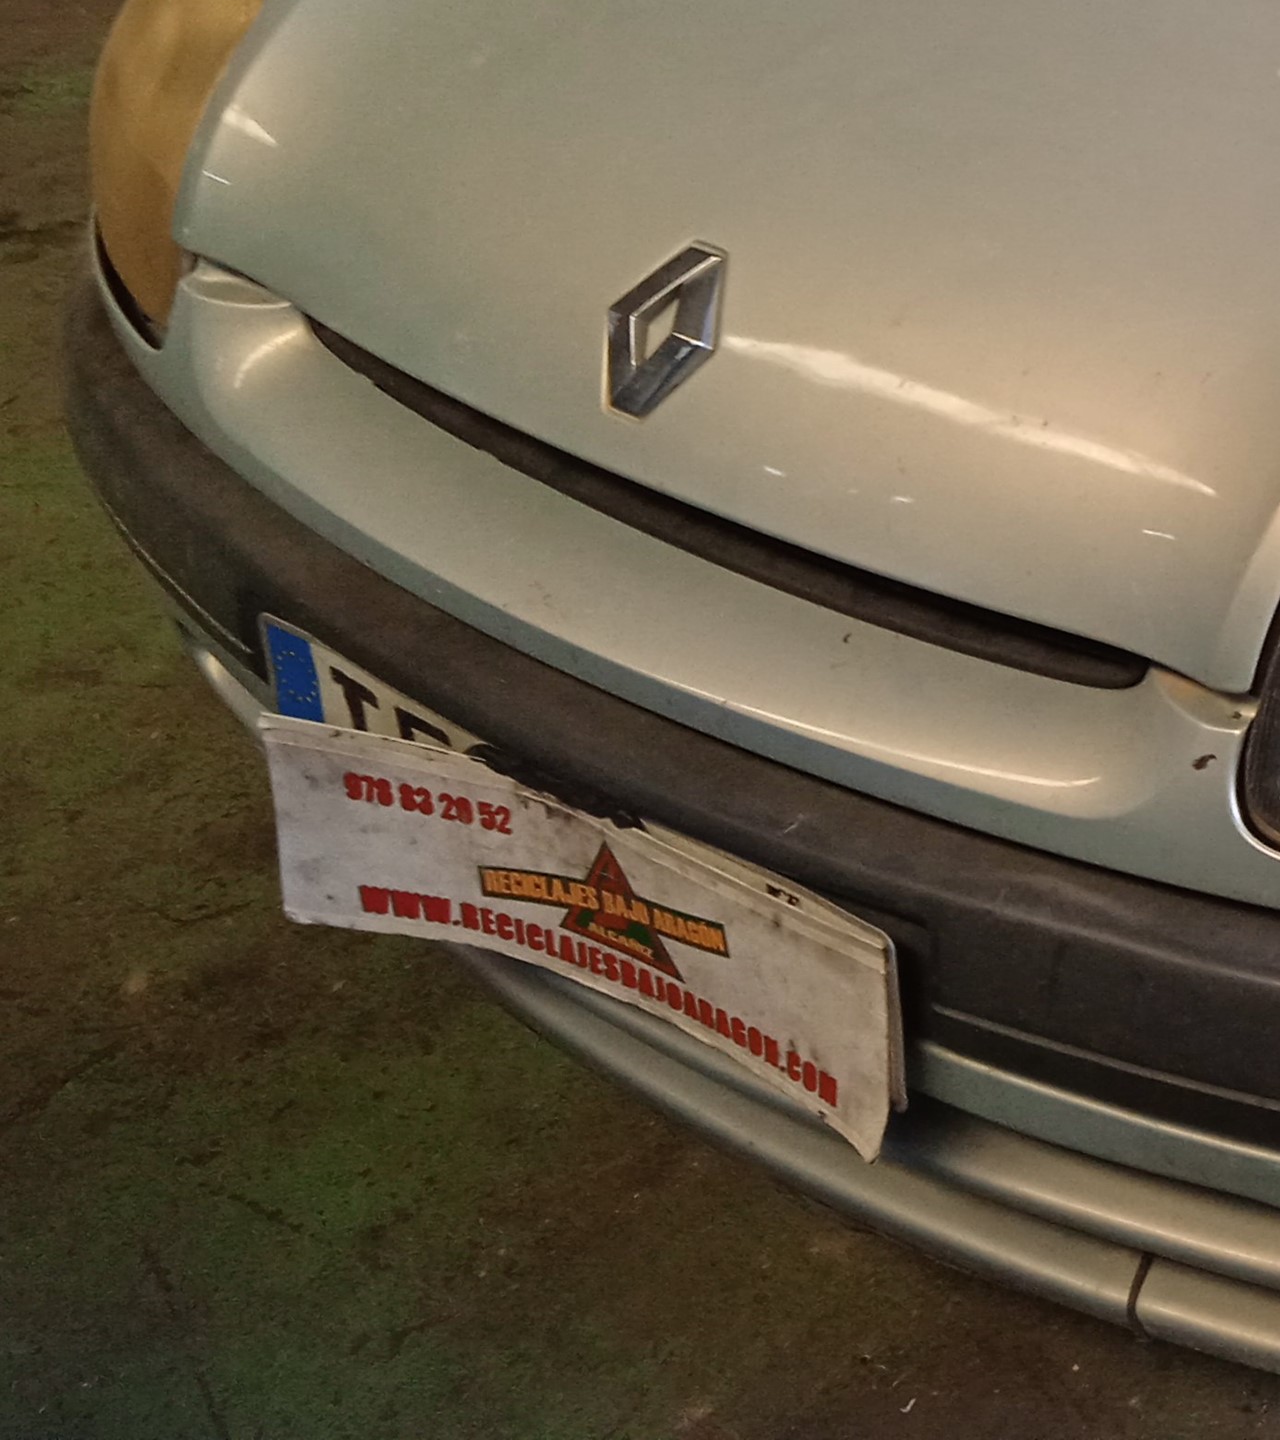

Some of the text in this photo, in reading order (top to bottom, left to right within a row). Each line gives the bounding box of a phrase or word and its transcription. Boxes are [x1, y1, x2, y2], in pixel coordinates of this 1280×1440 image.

[343, 772, 394, 807] 978
[399, 783, 434, 815] 83
[476, 801, 513, 835] 52
[483, 869, 600, 910] RECICLAJES
[601, 891, 650, 925] BAJO
